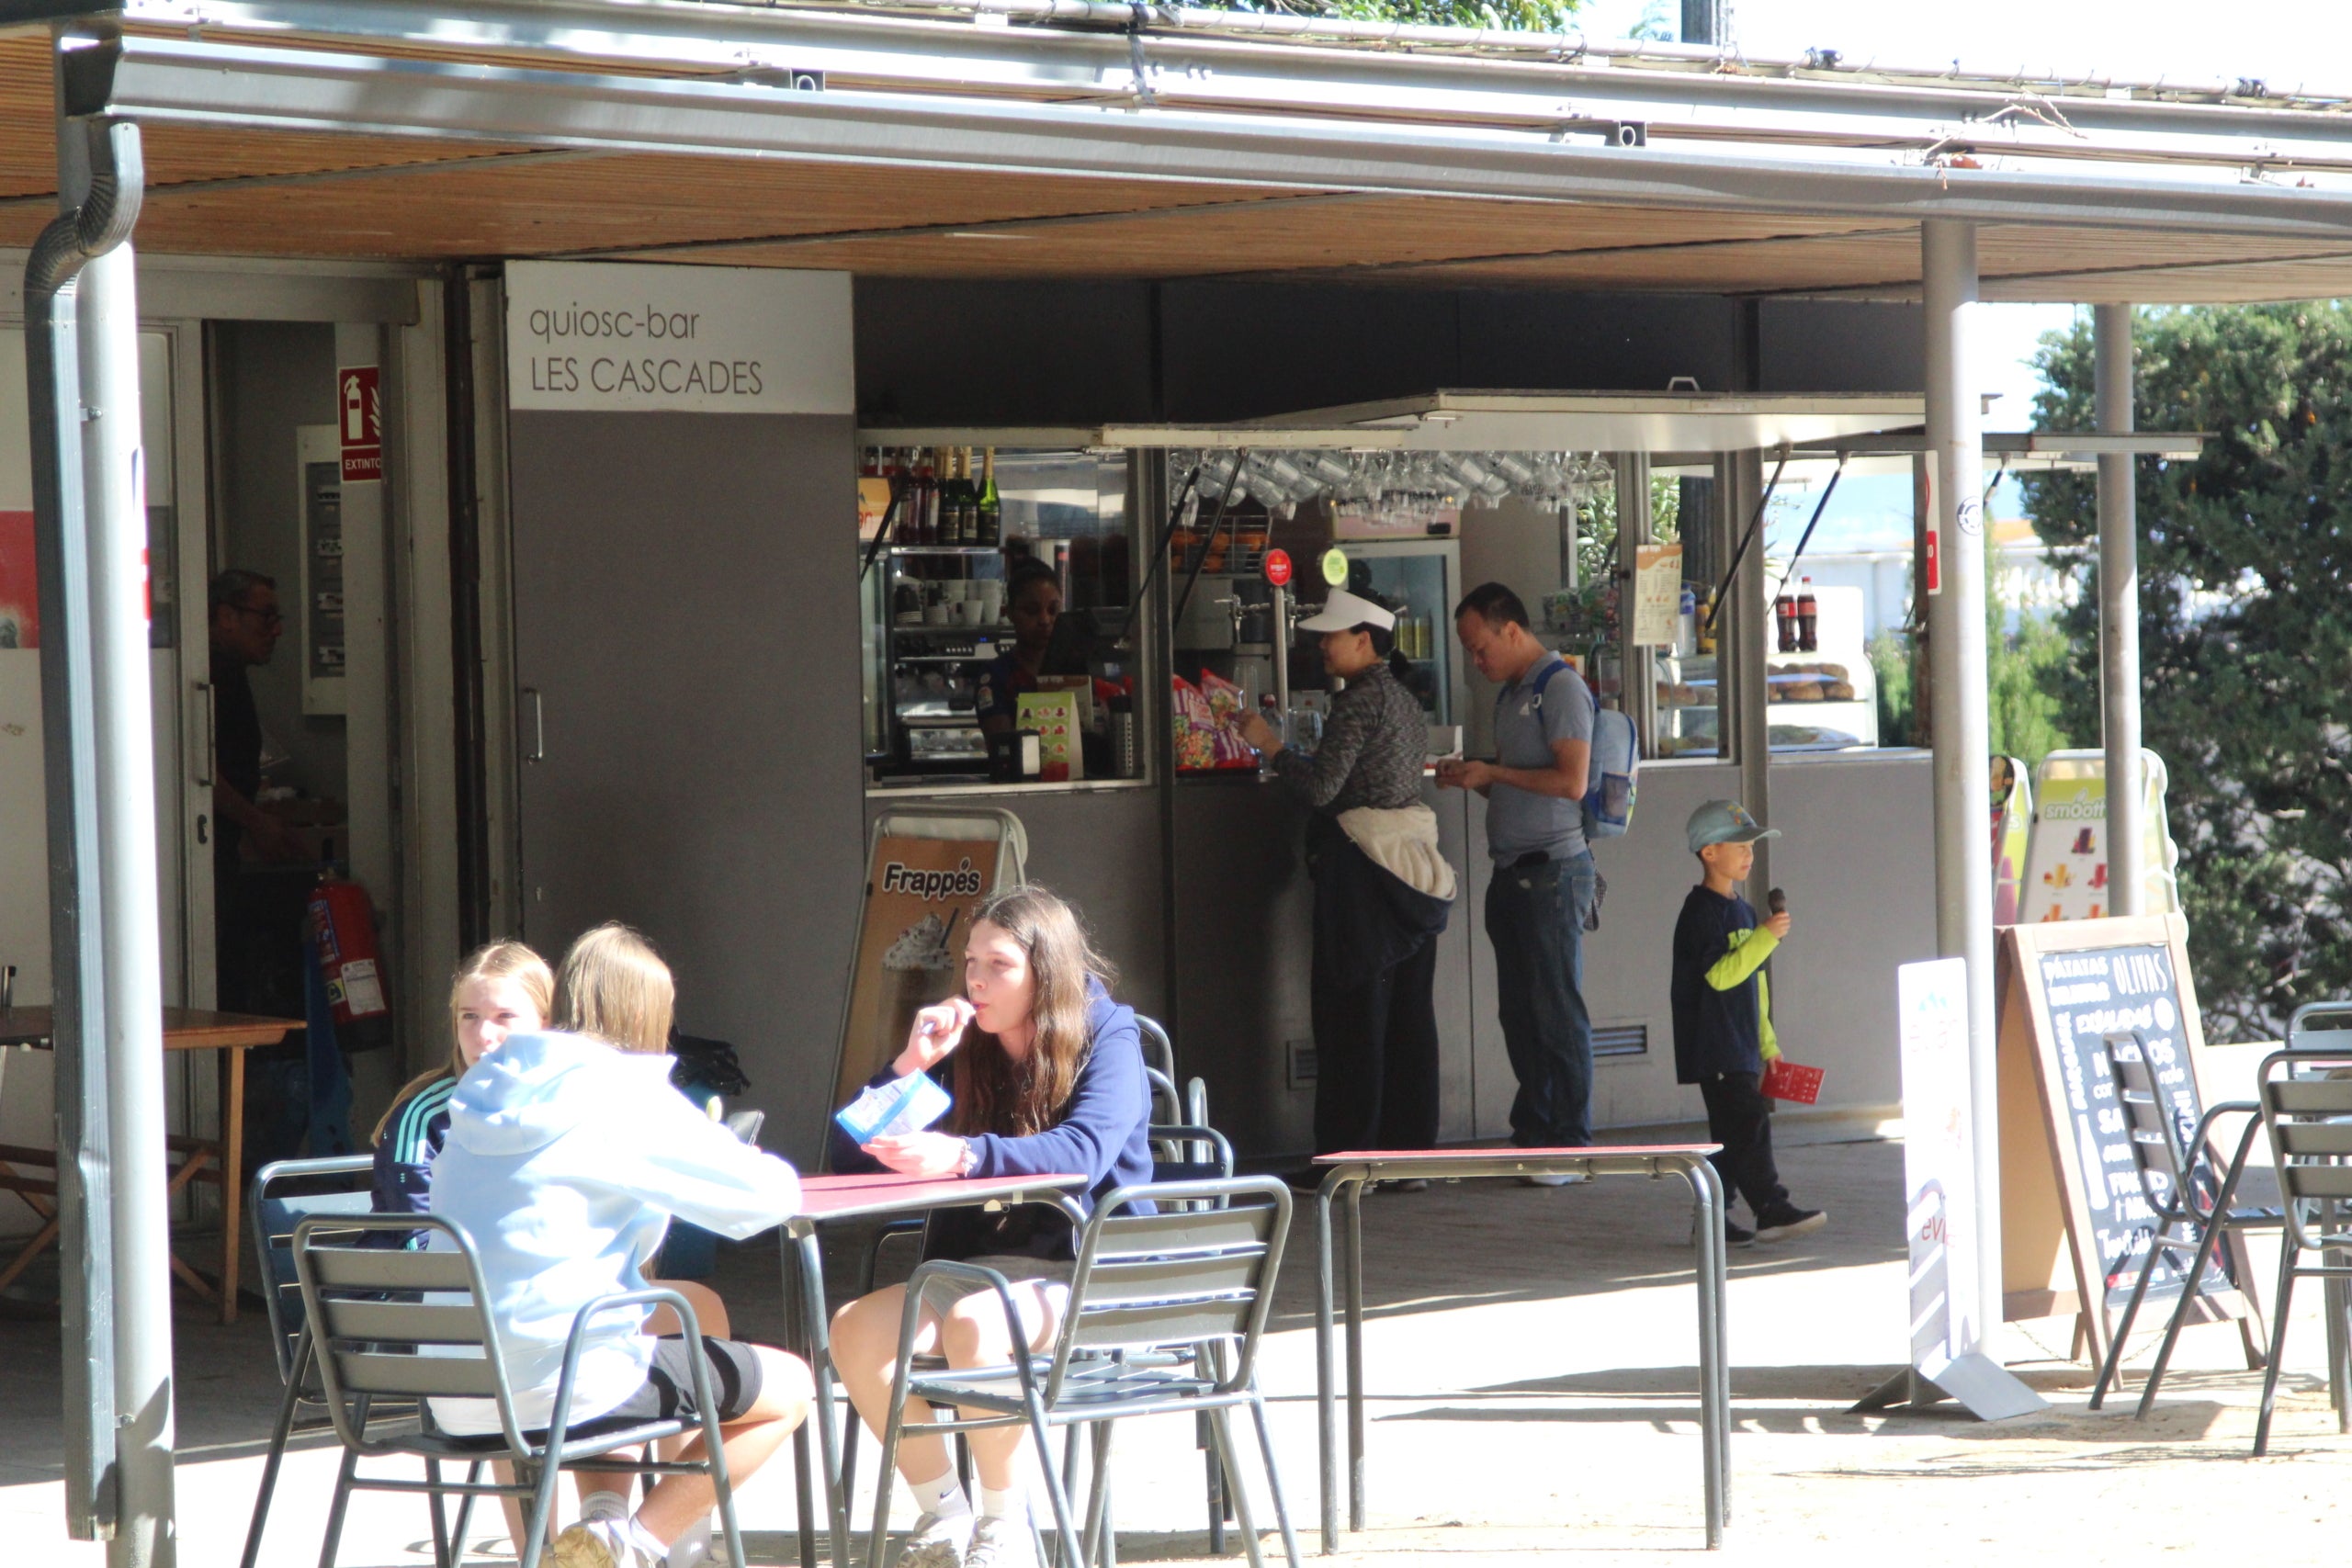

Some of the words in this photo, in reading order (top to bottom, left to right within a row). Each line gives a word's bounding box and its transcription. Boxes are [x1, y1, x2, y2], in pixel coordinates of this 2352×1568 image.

[529, 301, 700, 344] quiosc-bar
[532, 356, 579, 392] LES
[590, 357, 763, 397] CASCADES
[882, 856, 981, 900] Frappés
[2112, 953, 2169, 995] OLIVAS
